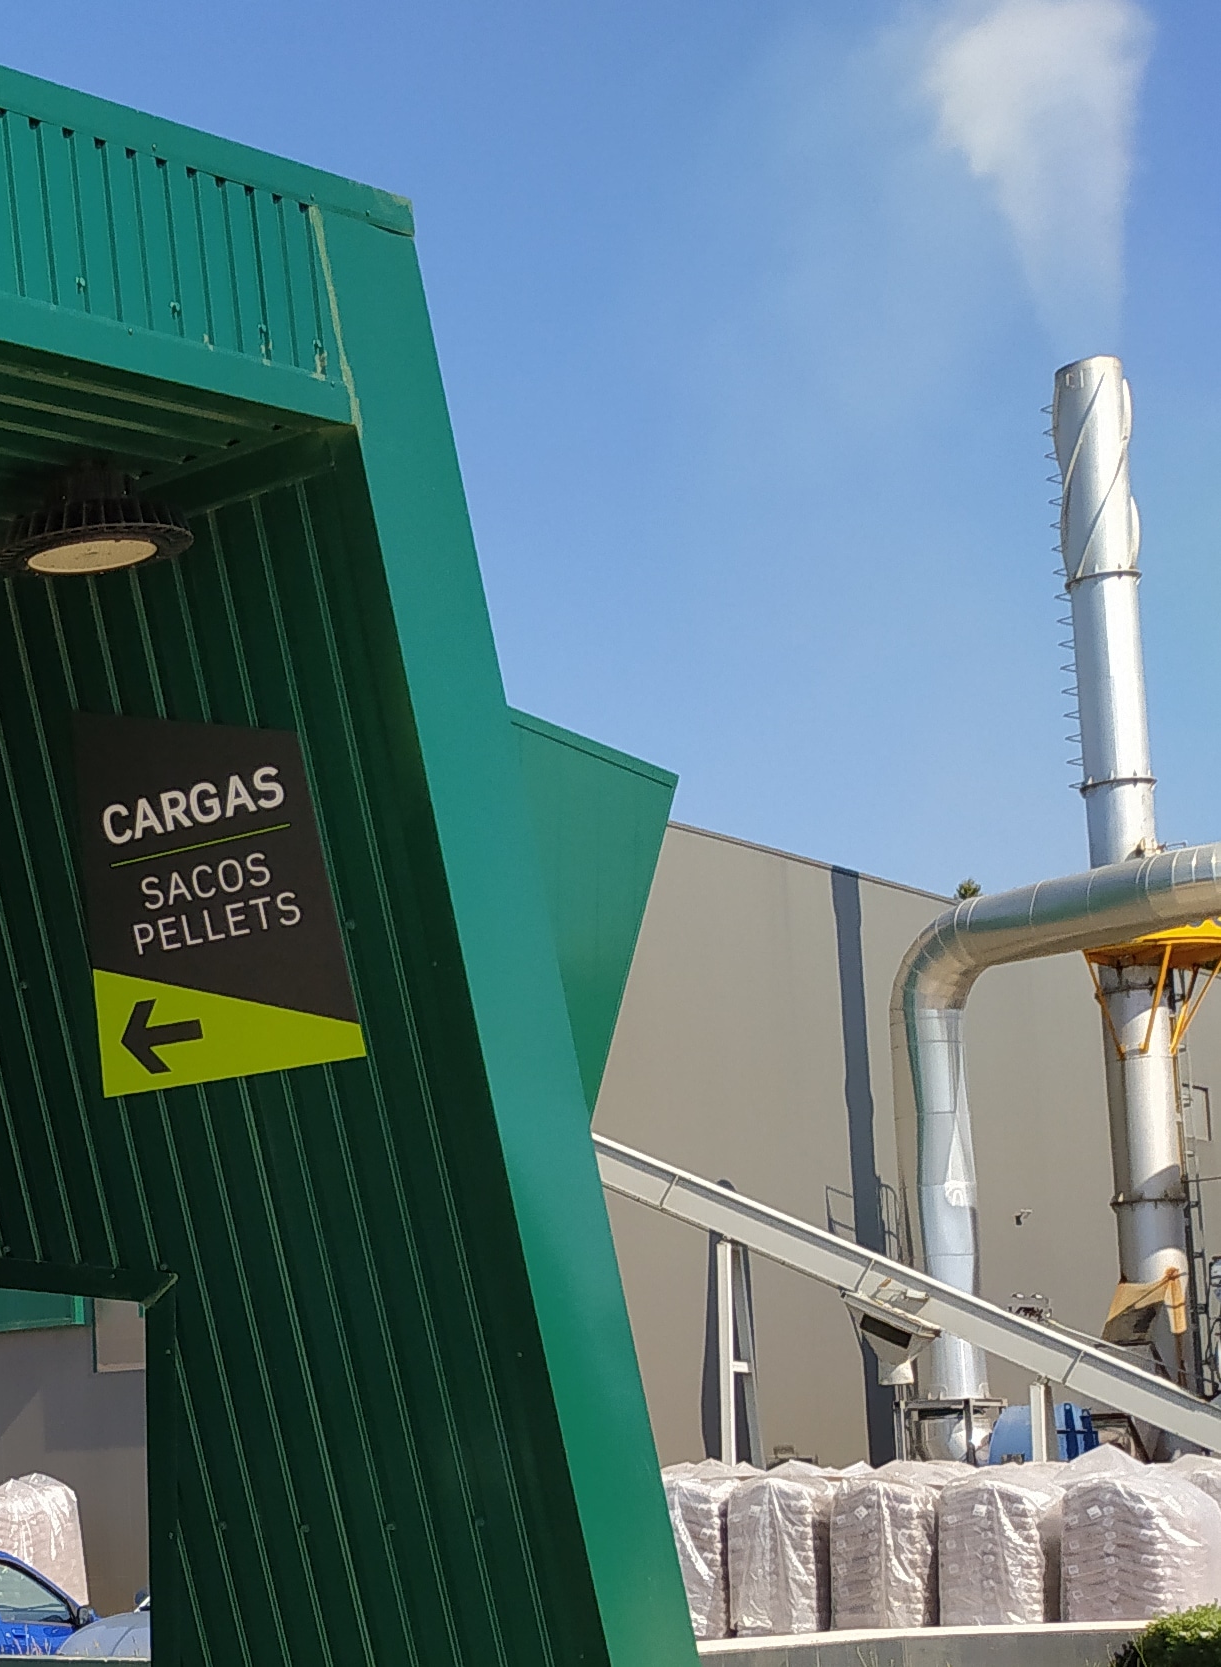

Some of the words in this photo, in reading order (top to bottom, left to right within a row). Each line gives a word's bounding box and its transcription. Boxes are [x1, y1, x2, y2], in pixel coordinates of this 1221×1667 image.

[102, 766, 285, 845] CARGAS
[140, 852, 271, 910] SACOS
[132, 891, 302, 956] PELLETS
